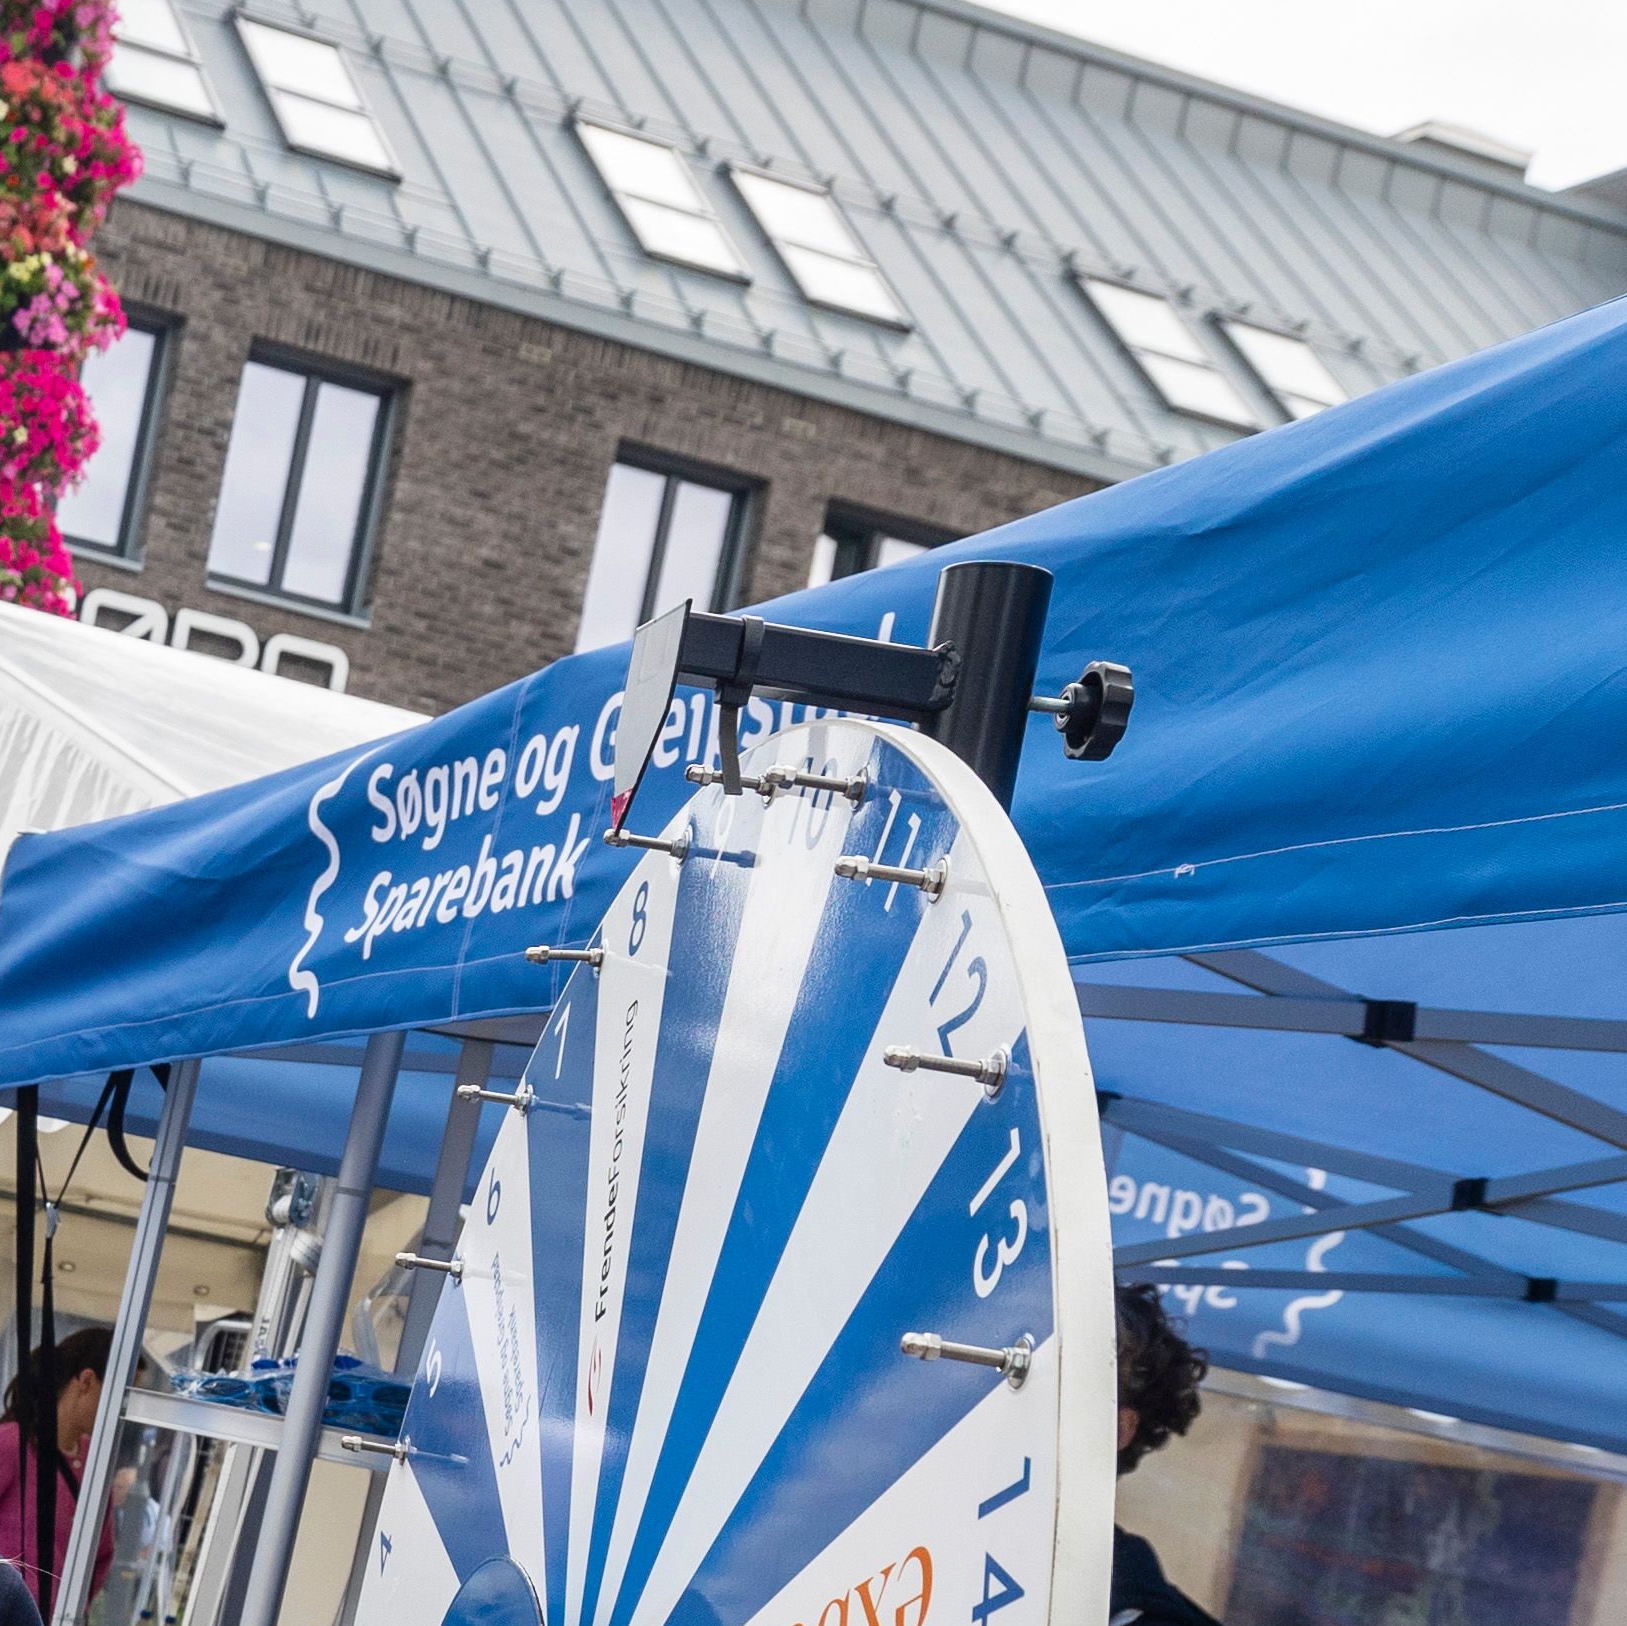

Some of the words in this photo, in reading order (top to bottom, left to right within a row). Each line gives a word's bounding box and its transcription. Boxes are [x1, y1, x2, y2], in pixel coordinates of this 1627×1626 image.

[367, 746, 507, 850] Søgne
[515, 724, 581, 816] og
[786, 756, 842, 850] 10
[343, 813, 590, 960] Sparebank
[711, 804, 737, 880] 9
[865, 788, 921, 912] 11
[628, 880, 648, 957] 8
[929, 910, 987, 1058] 12
[485, 1166, 501, 1226] 6
[969, 1128, 1028, 1298] 13
[426, 1338, 443, 1398] 5
[380, 1530, 392, 1577] 4
